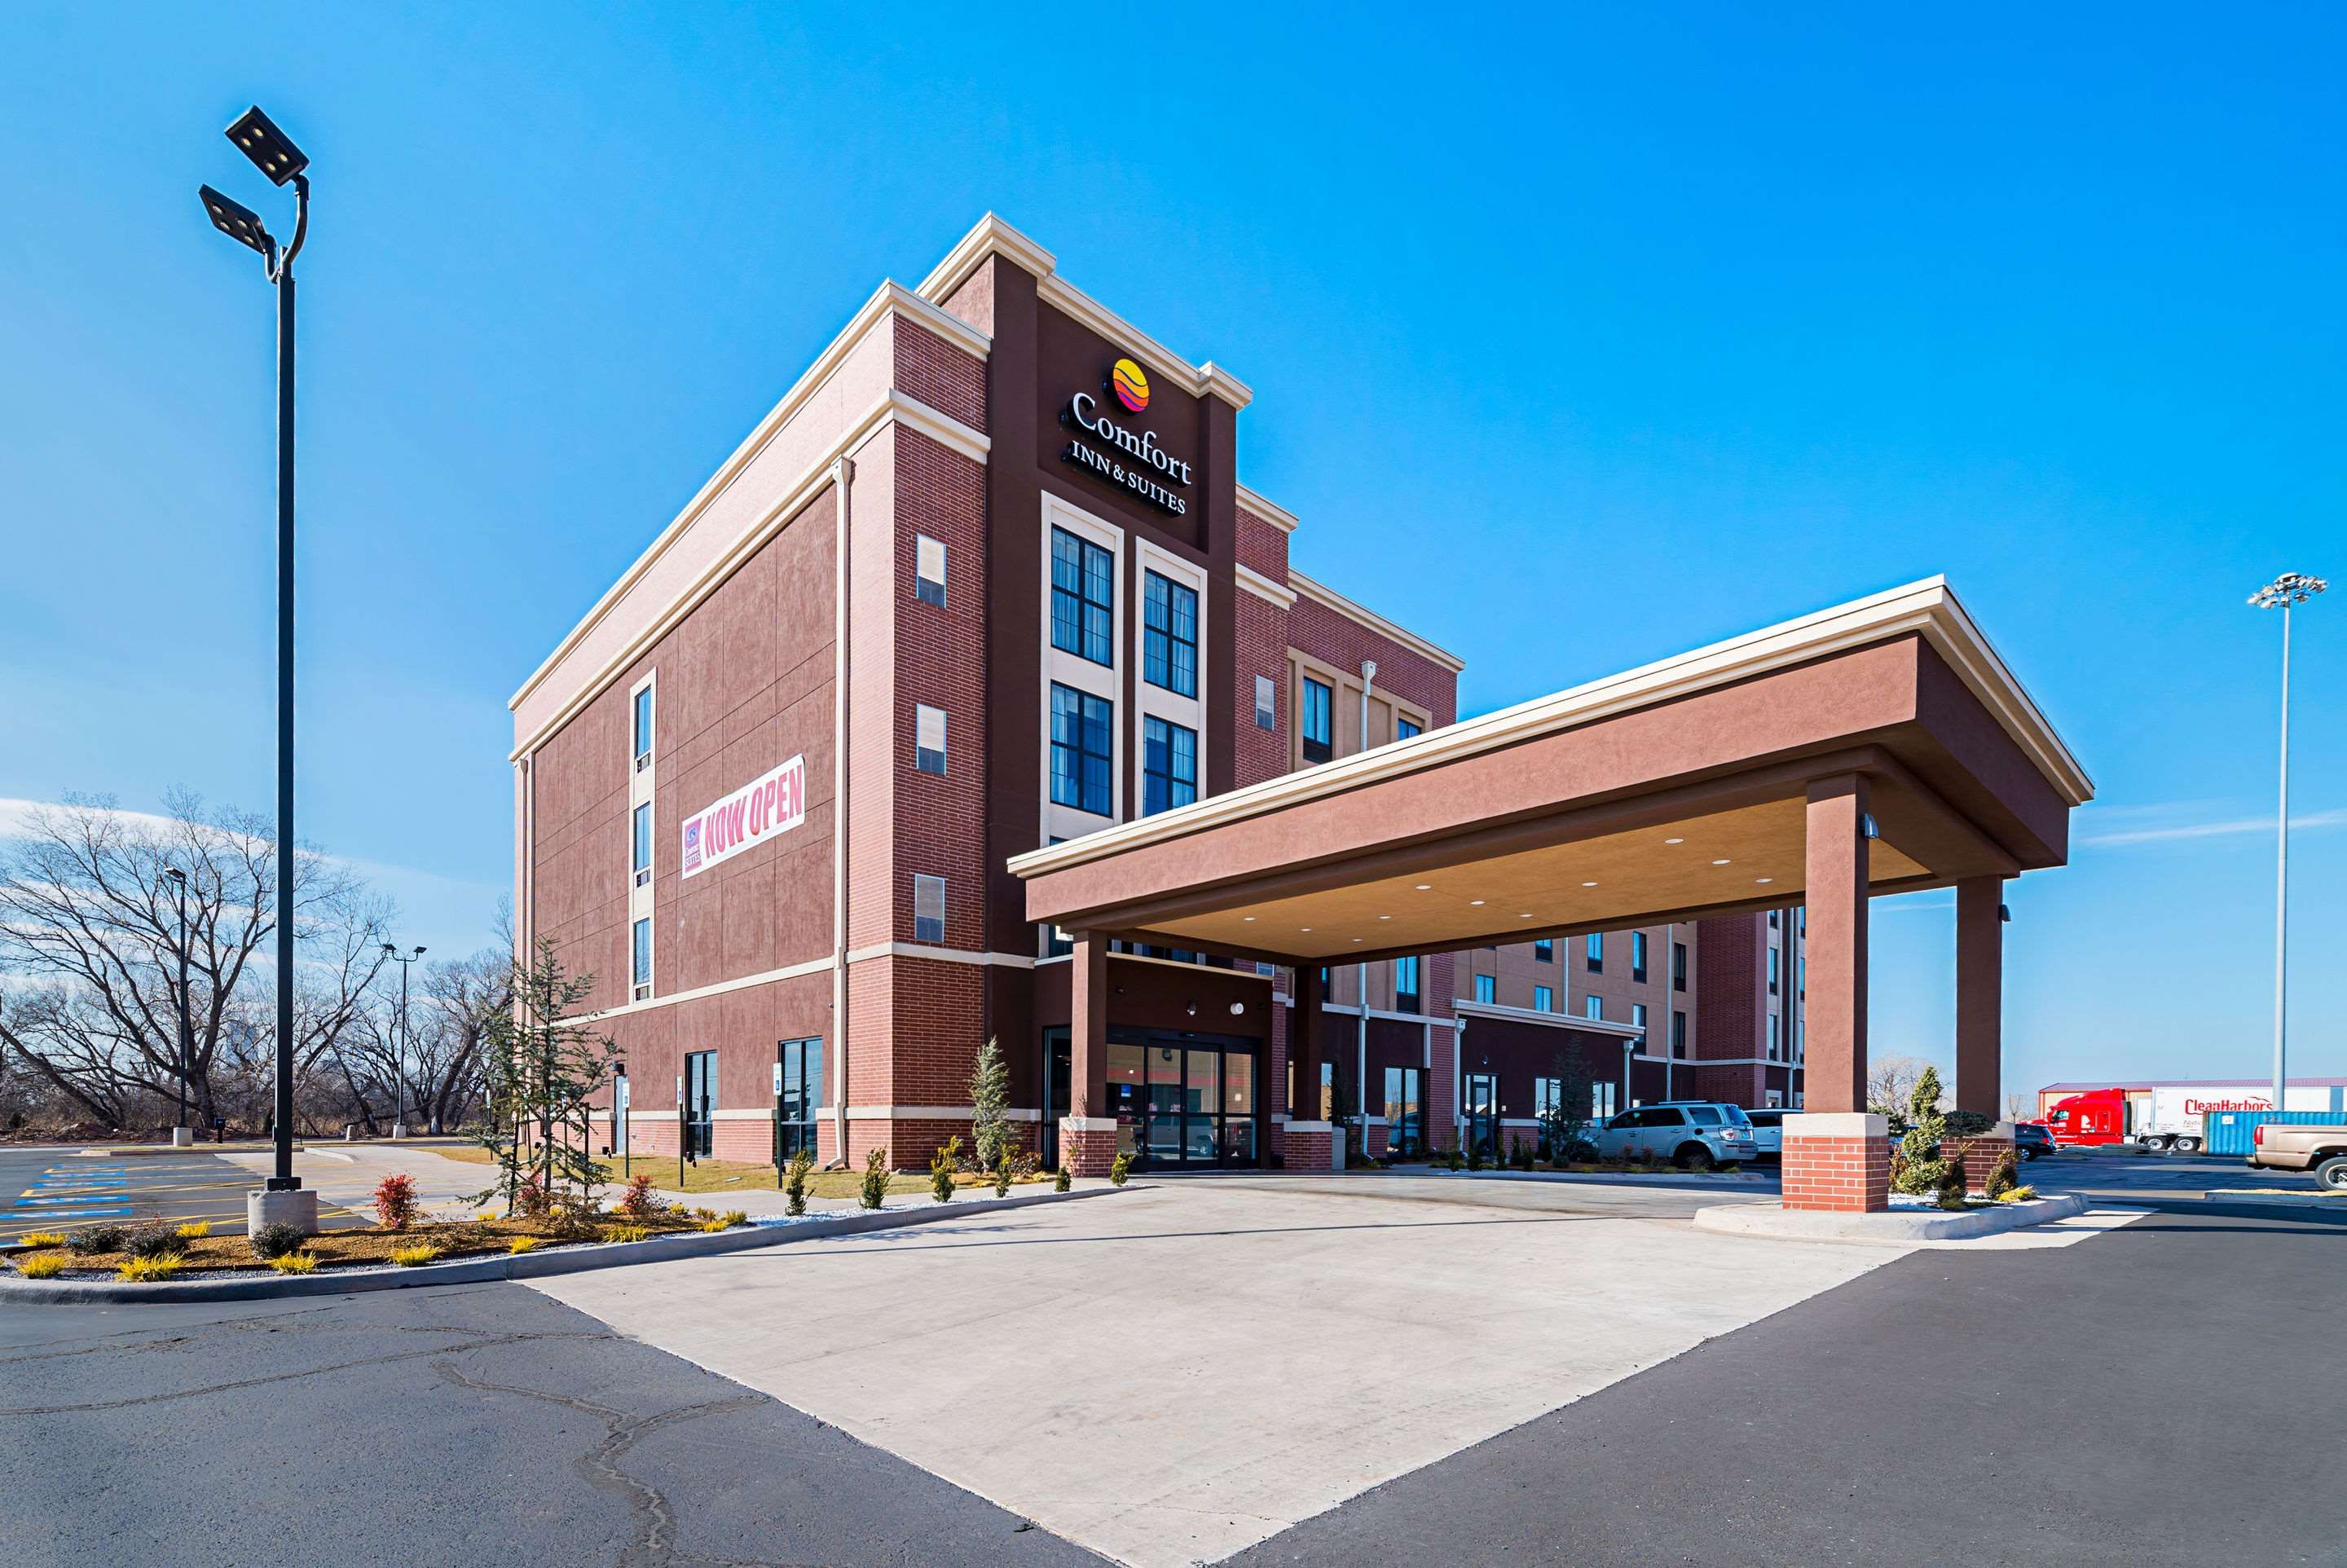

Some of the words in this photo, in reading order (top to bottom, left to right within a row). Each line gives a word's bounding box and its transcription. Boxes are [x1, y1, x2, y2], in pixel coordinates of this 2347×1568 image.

[1072, 392, 1191, 485] Comfort
[1072, 440, 1111, 475] INN
[1113, 464, 1125, 482] &
[1128, 472, 1186, 514] SUITES
[705, 795, 747, 859] NOW
[749, 764, 802, 836] OPEN
